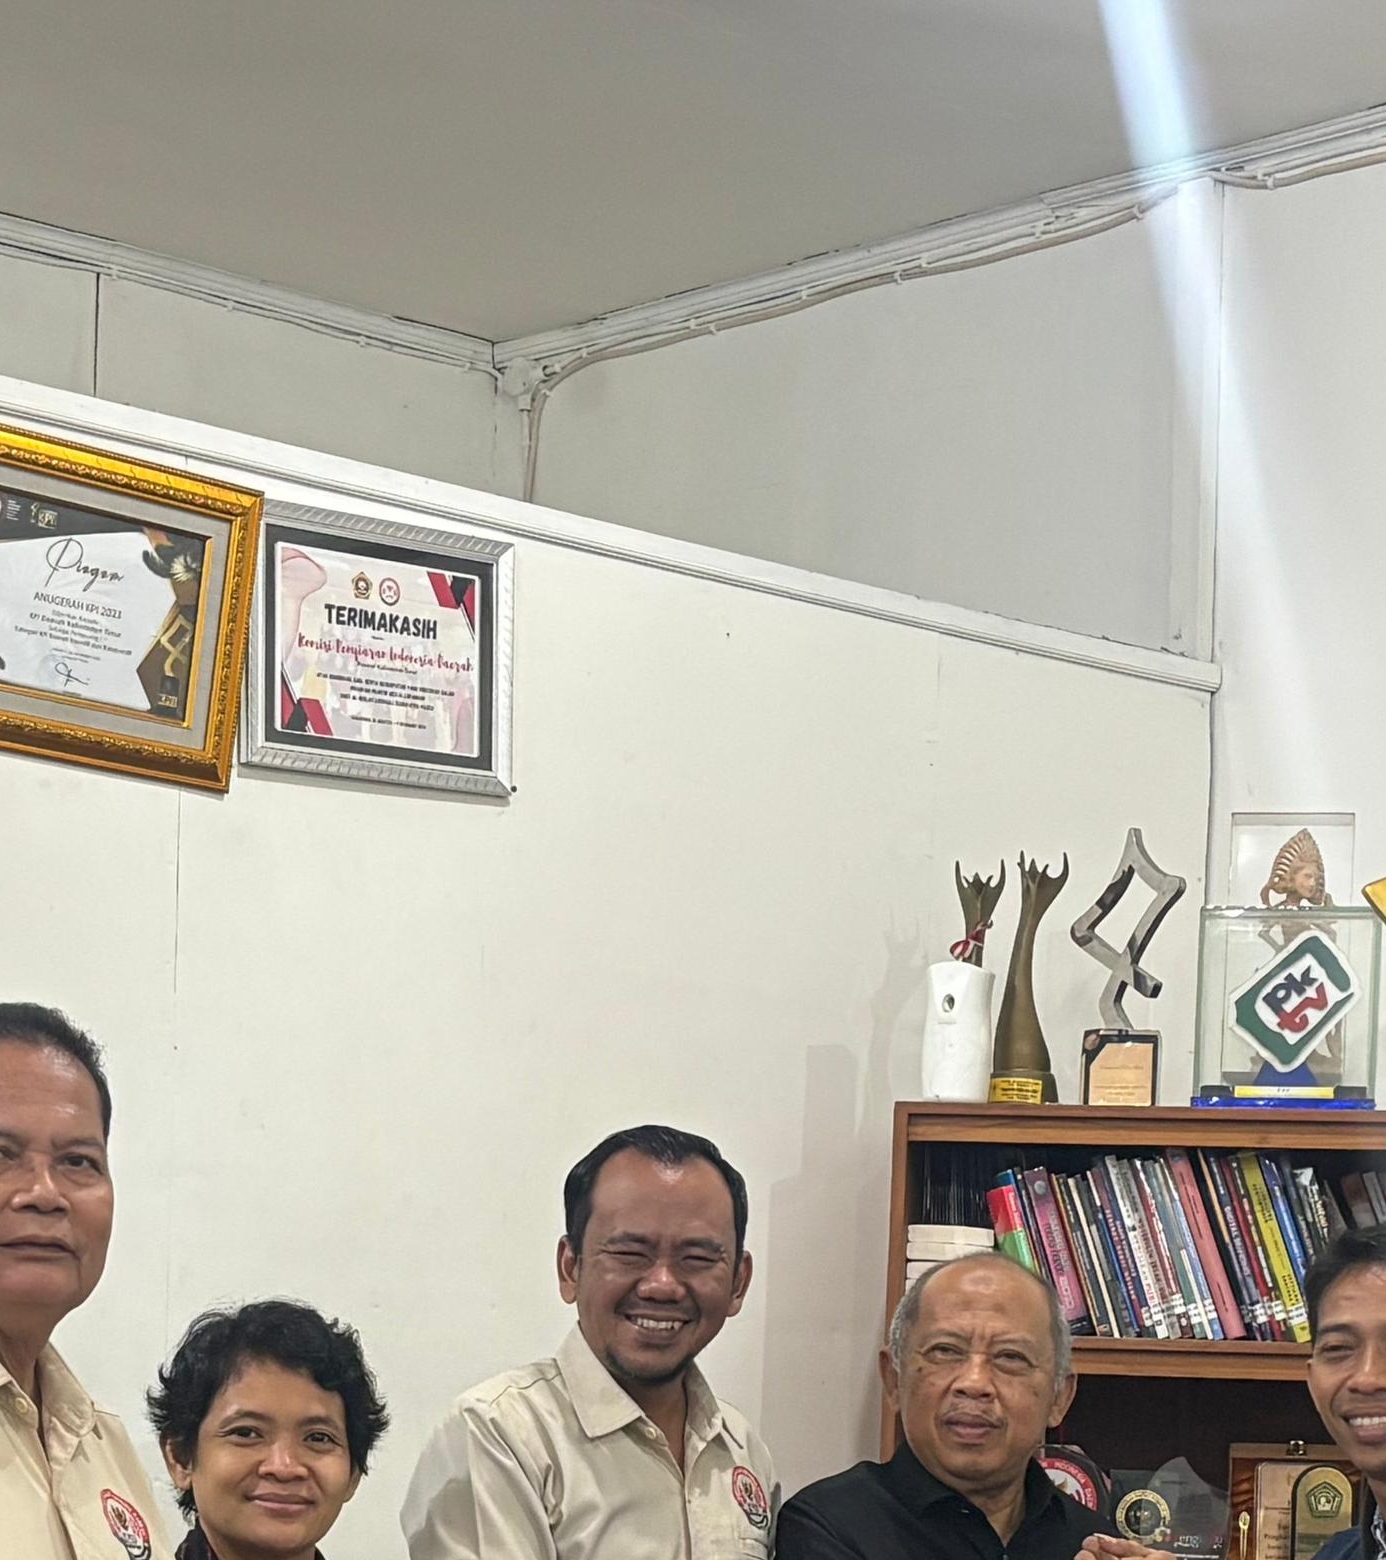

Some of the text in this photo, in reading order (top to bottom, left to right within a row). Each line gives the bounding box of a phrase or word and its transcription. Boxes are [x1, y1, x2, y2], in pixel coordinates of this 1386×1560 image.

[33, 591, 84, 610] ANUGERAH
[324, 603, 438, 640] TERIMAKASIH
[335, 638, 386, 663] Penyiaran
[390, 646, 433, 667] Indonesia
